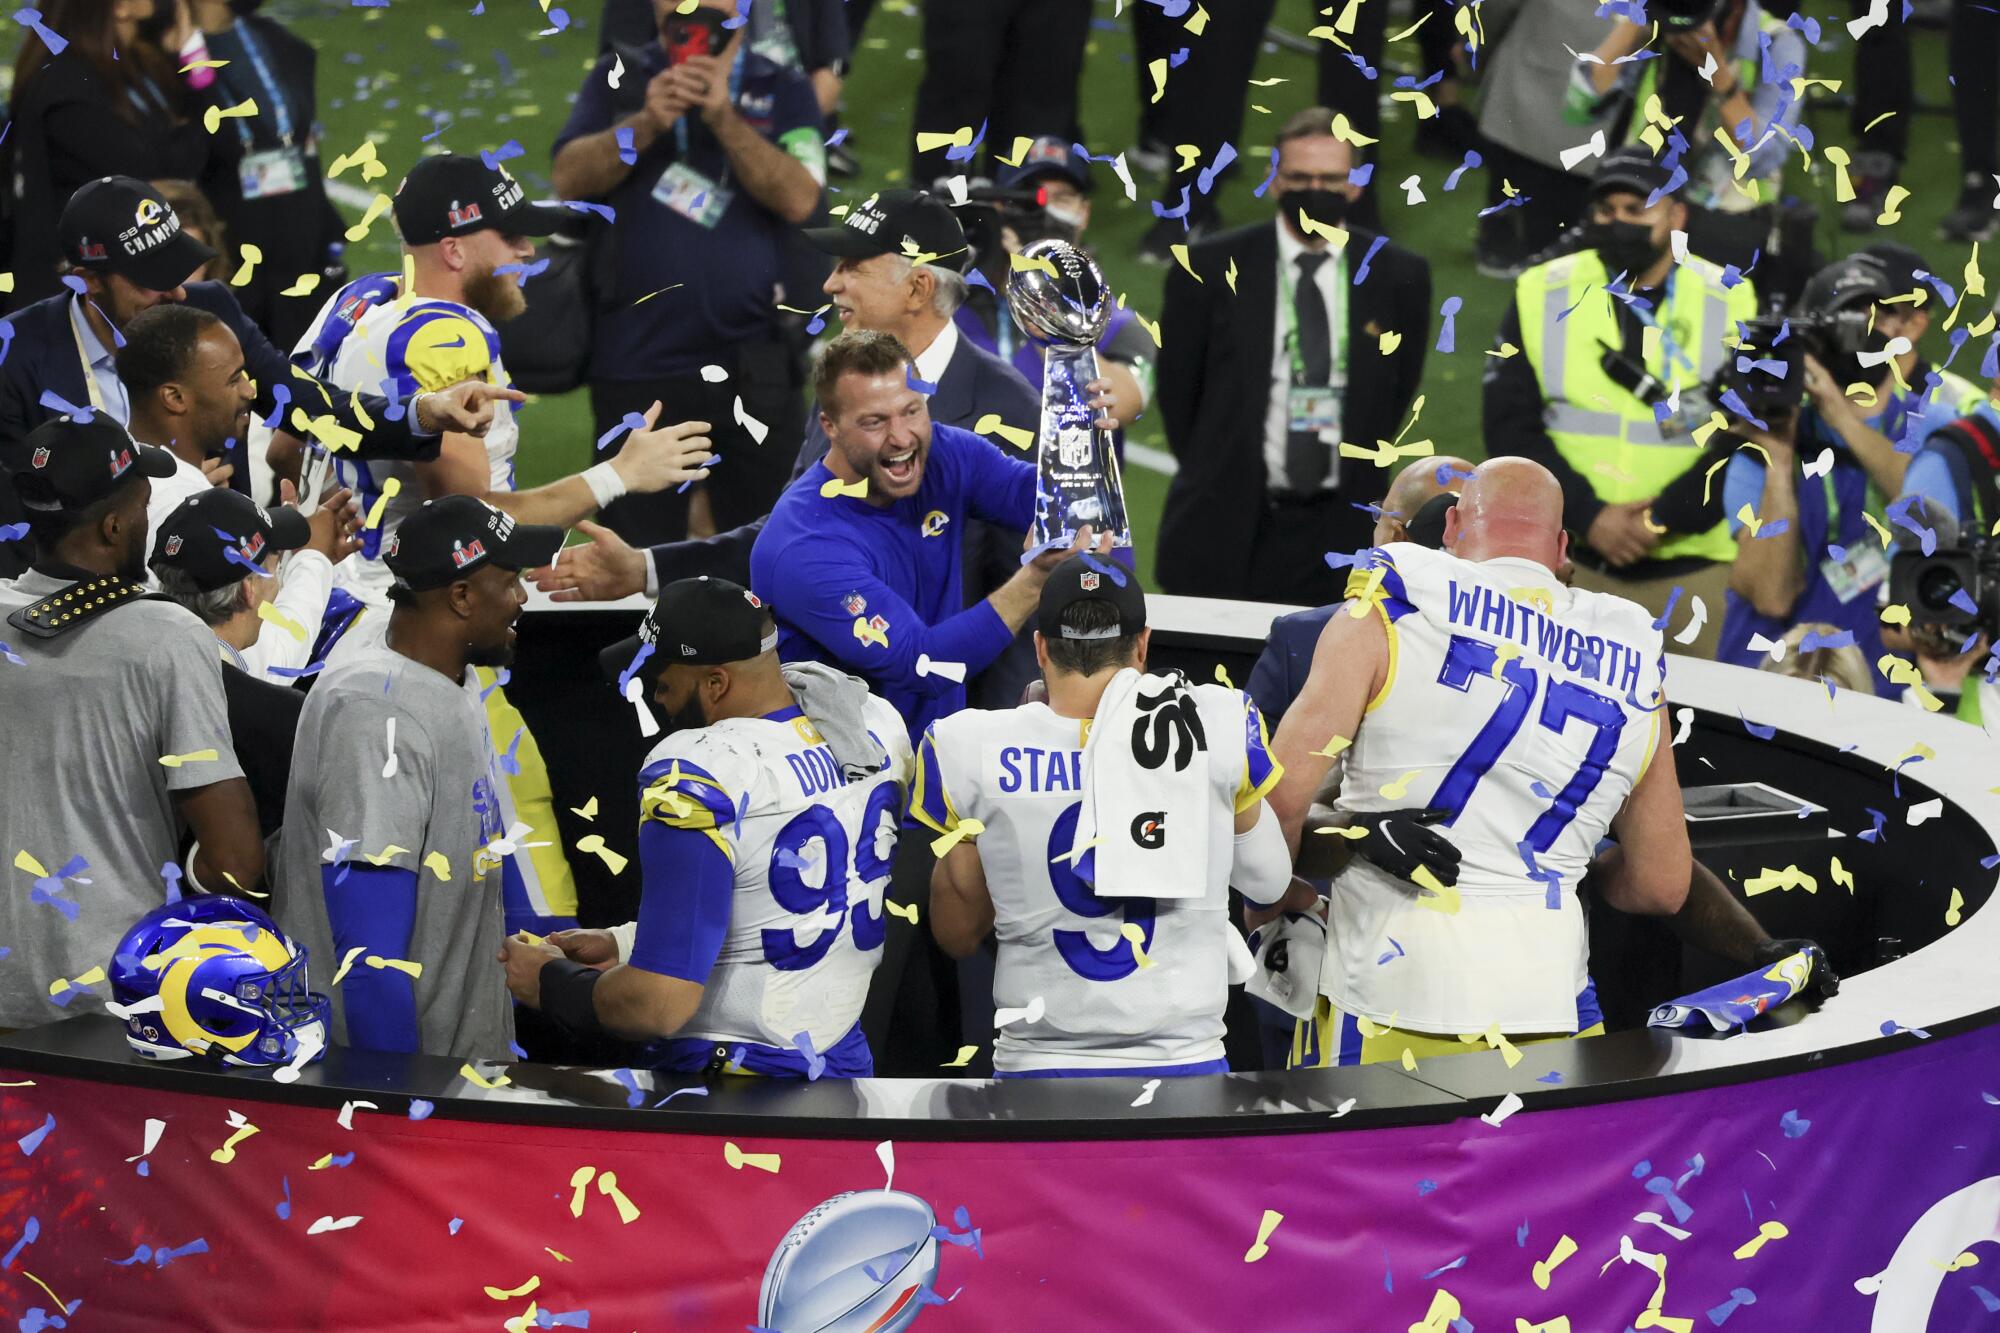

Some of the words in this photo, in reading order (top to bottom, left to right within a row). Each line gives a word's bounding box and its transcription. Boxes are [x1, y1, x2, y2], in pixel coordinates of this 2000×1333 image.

[119, 226, 138, 241] SB
[869, 209, 887, 221] LVI
[488, 515, 498, 530] SB
[650, 619, 660, 634] LVI
[1449, 580, 1641, 697] WHITWORTH
[1428, 634, 1627, 853] 77
[1130, 811, 1167, 850] G
[761, 780, 904, 971] 99
[1047, 800, 1157, 982] 9
